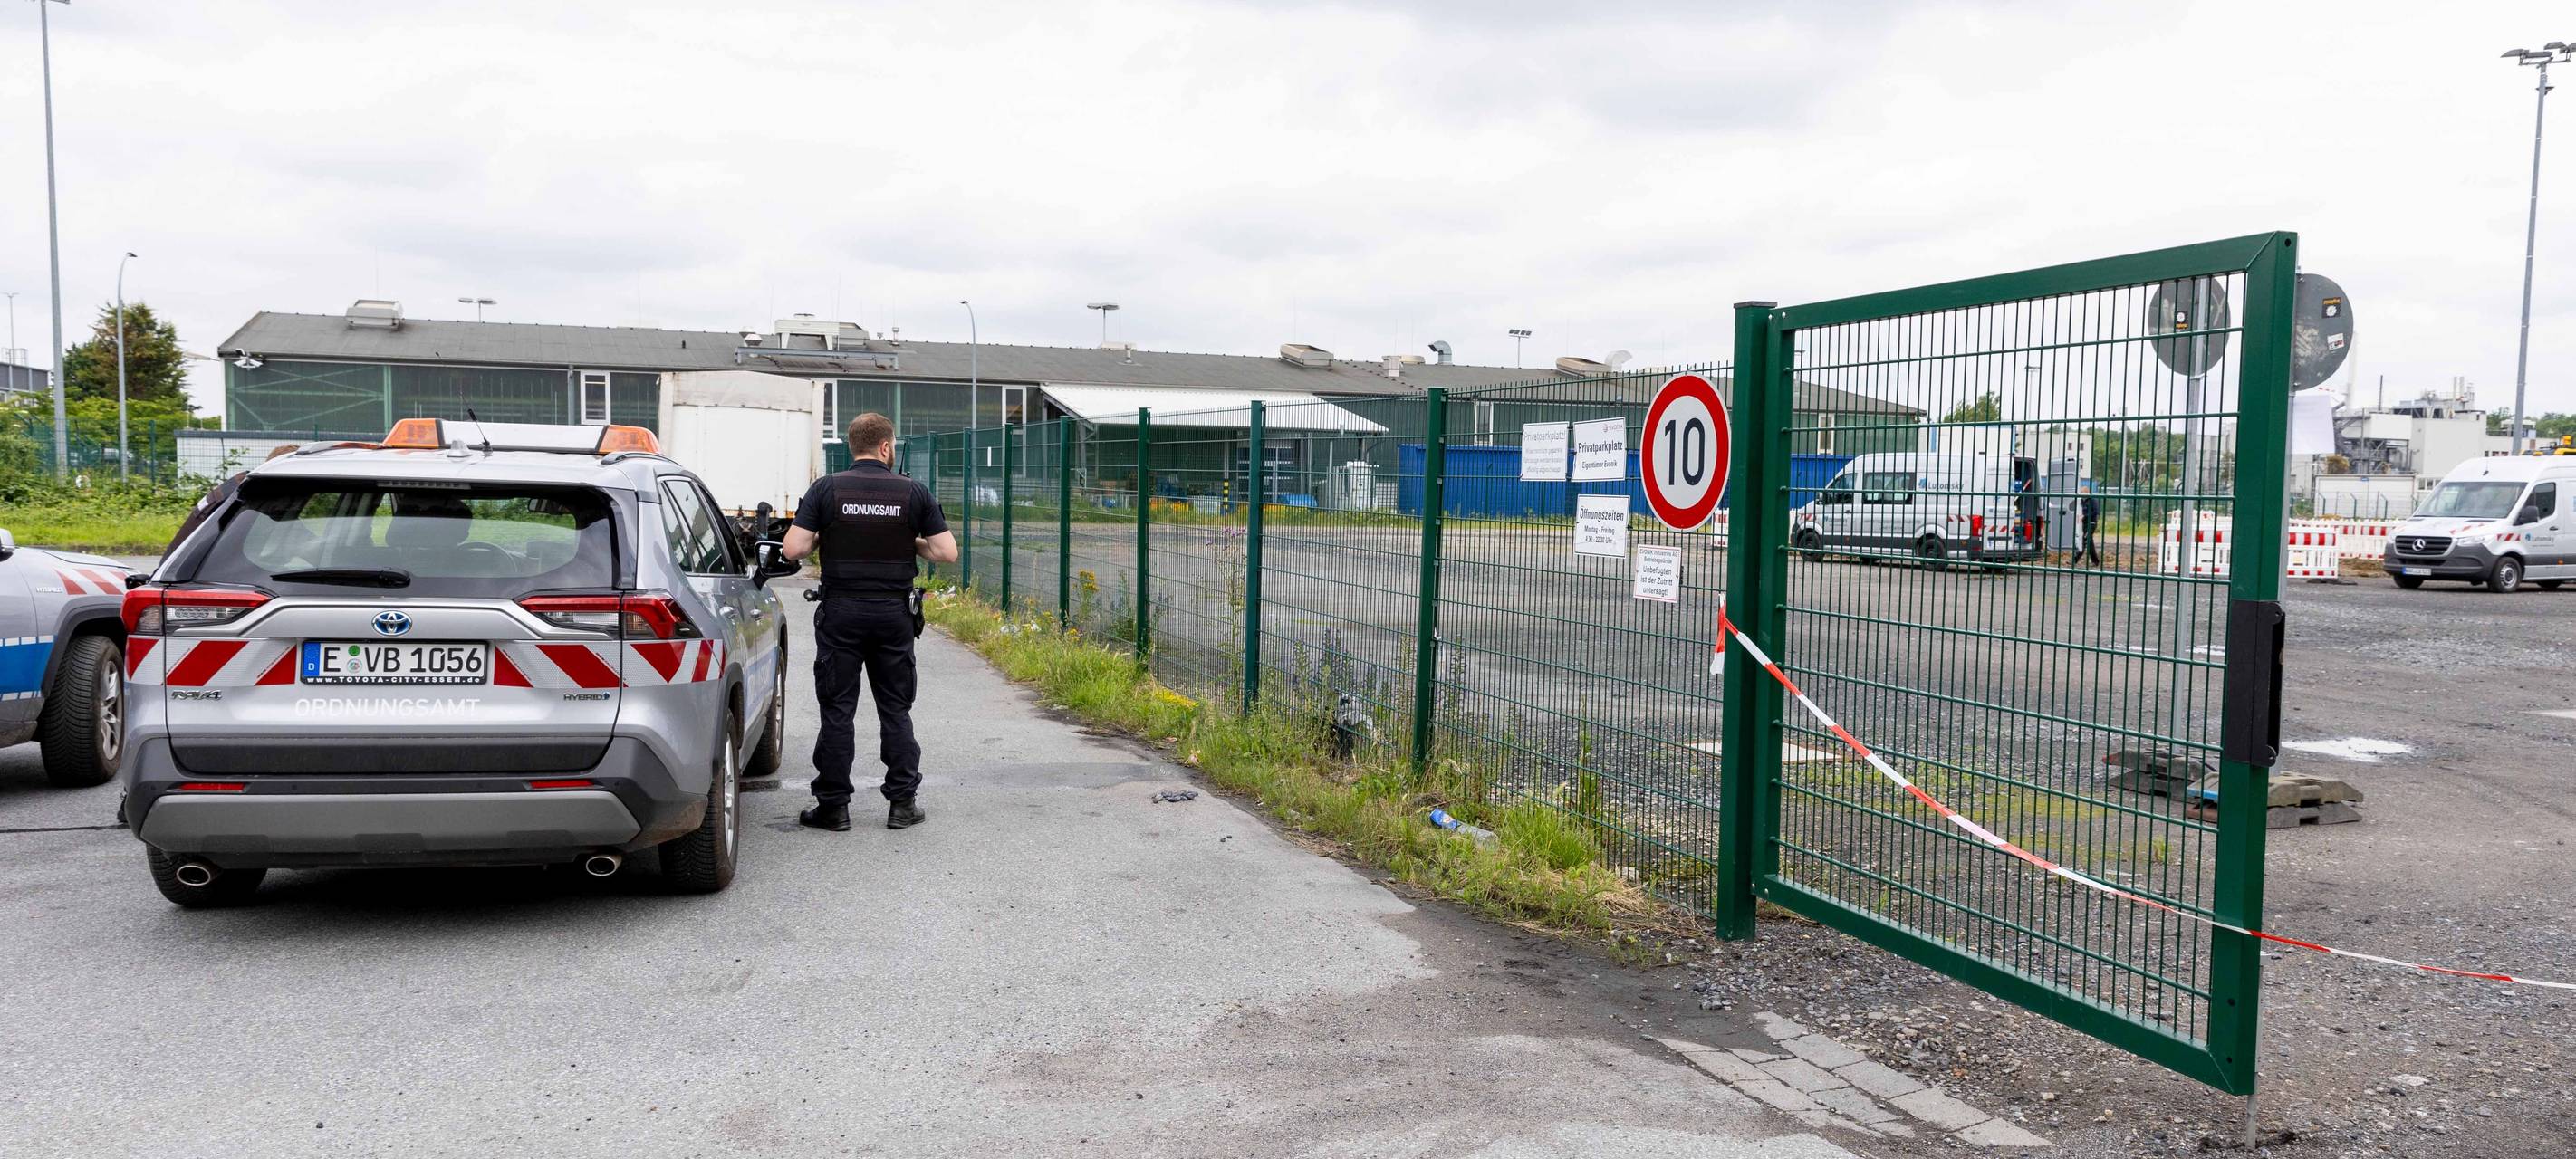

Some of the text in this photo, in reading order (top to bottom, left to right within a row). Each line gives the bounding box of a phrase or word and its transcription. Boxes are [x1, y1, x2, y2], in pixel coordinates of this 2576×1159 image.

[1578, 440, 1623, 455] Privatparkplatz
[1665, 417, 1705, 485] 10
[842, 503, 901, 516] ORDNUNGSAMT
[1580, 505, 1624, 522] Öffnungszeiten
[1643, 565, 1672, 577] Unbefugten
[1657, 577, 1673, 586] Zutritt
[307, 647, 482, 673] D E VB 1056
[171, 689, 223, 701] RAV4
[563, 693, 603, 701] HYBRID
[294, 698, 481, 717] ORDNUNGSAMT
